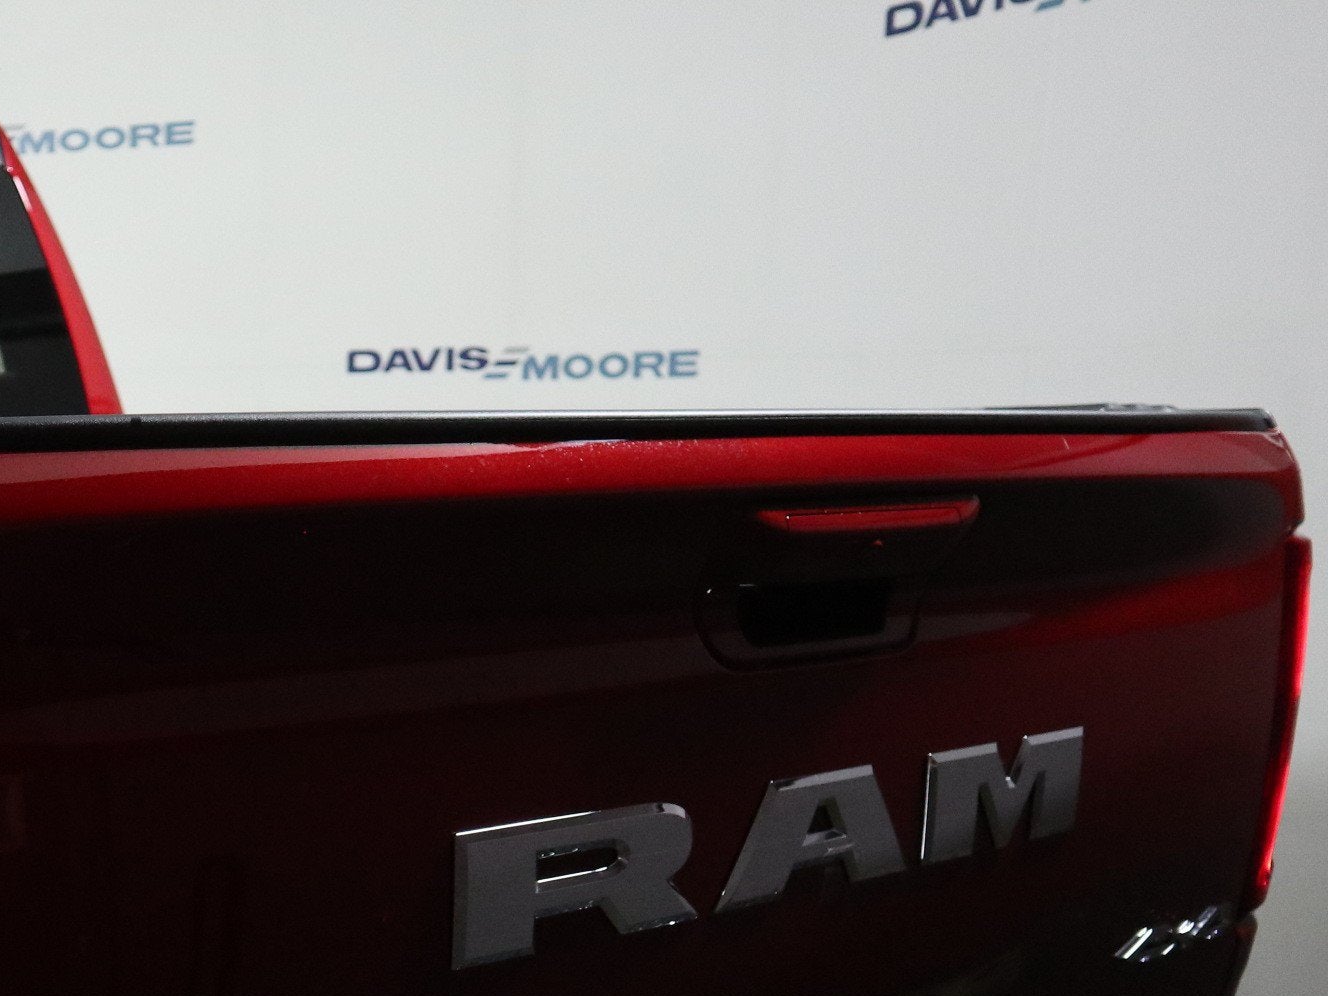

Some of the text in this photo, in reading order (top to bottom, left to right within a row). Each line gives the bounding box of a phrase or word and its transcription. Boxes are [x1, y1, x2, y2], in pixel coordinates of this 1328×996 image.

[885, 0, 1030, 36] DAV
[18, 119, 195, 154] MOORE
[347, 346, 700, 380] DAVIS MOORE
[451, 726, 1084, 970] RAM
